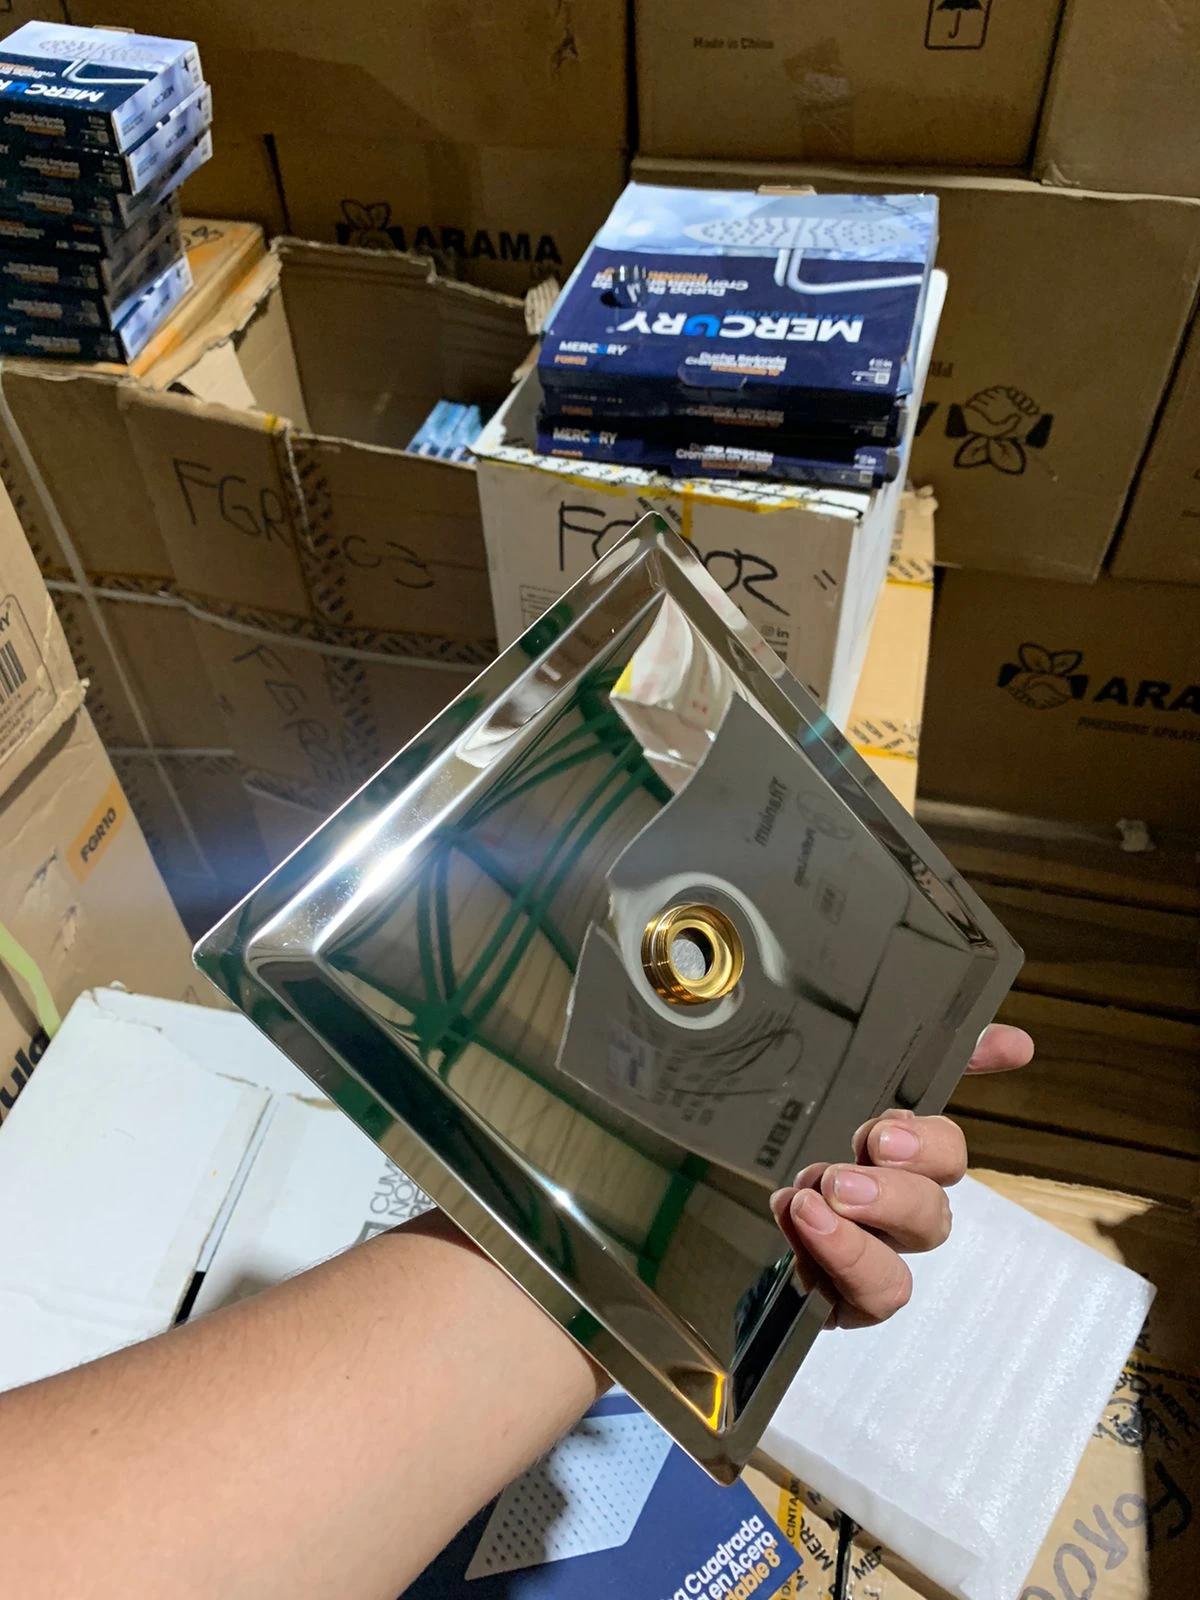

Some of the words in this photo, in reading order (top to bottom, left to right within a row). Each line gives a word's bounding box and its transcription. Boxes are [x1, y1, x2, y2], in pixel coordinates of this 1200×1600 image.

[415, 226, 562, 266] ARAMA
[617, 311, 864, 344] MERCURY
[558, 340, 627, 356] MERCURY
[552, 427, 617, 445] MERCURY
[79, 806, 118, 864] FOR10
[684, 1514, 765, 1596] Cuadrada
[708, 1572, 732, 1597] en
[731, 1530, 775, 1582] Acero
